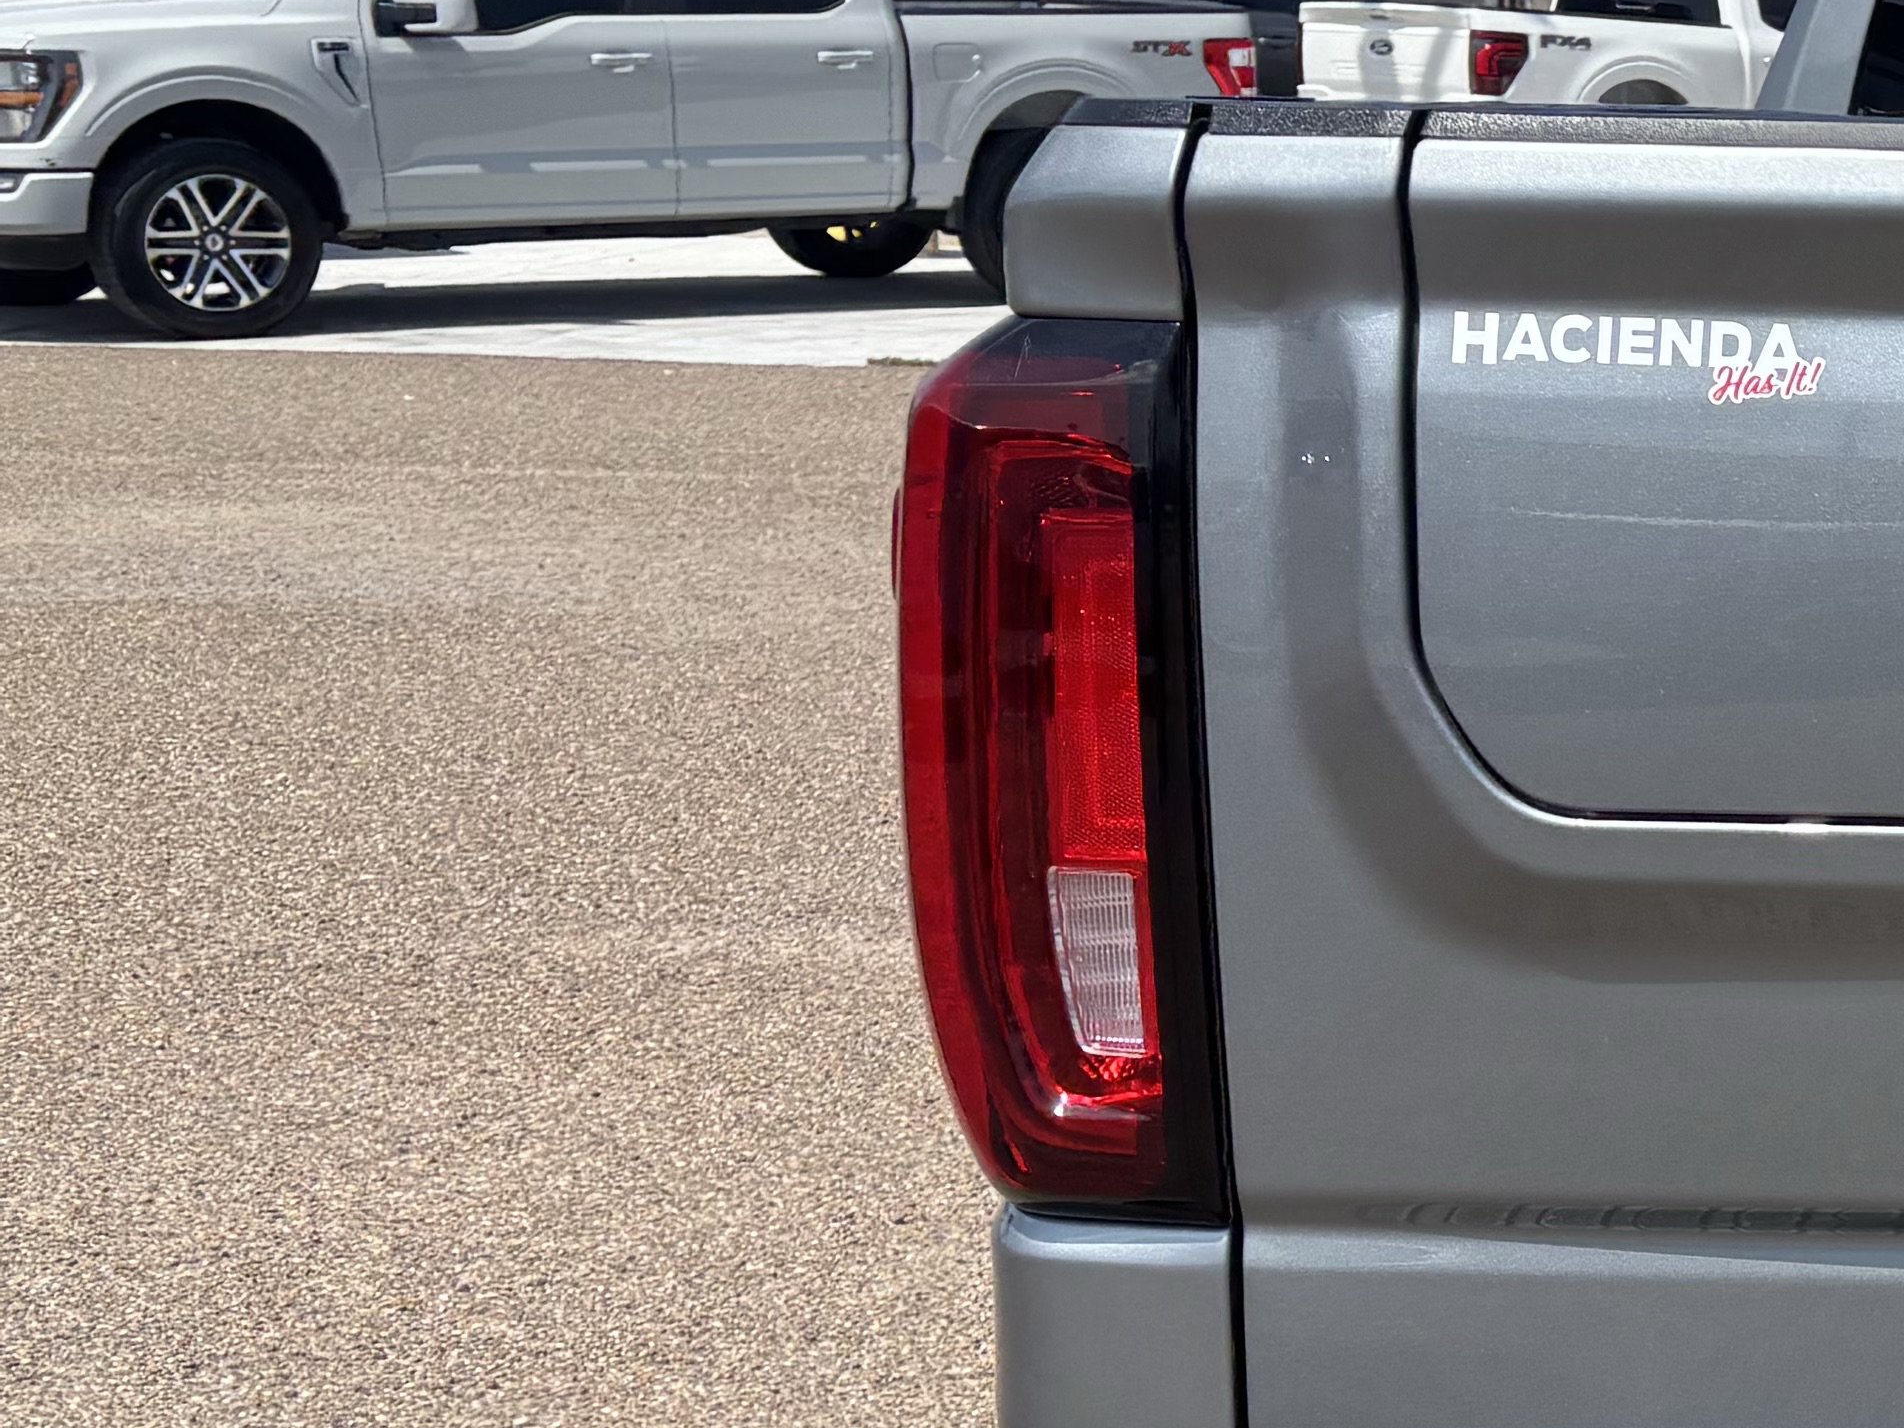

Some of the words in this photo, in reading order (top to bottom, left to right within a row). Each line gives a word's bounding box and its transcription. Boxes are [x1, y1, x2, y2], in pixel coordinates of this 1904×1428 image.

[1540, 34, 1592, 51] FX4
[1451, 310, 1802, 379] HACIENDA
[1712, 364, 1776, 403] Has
[1783, 361, 1822, 394] It!
